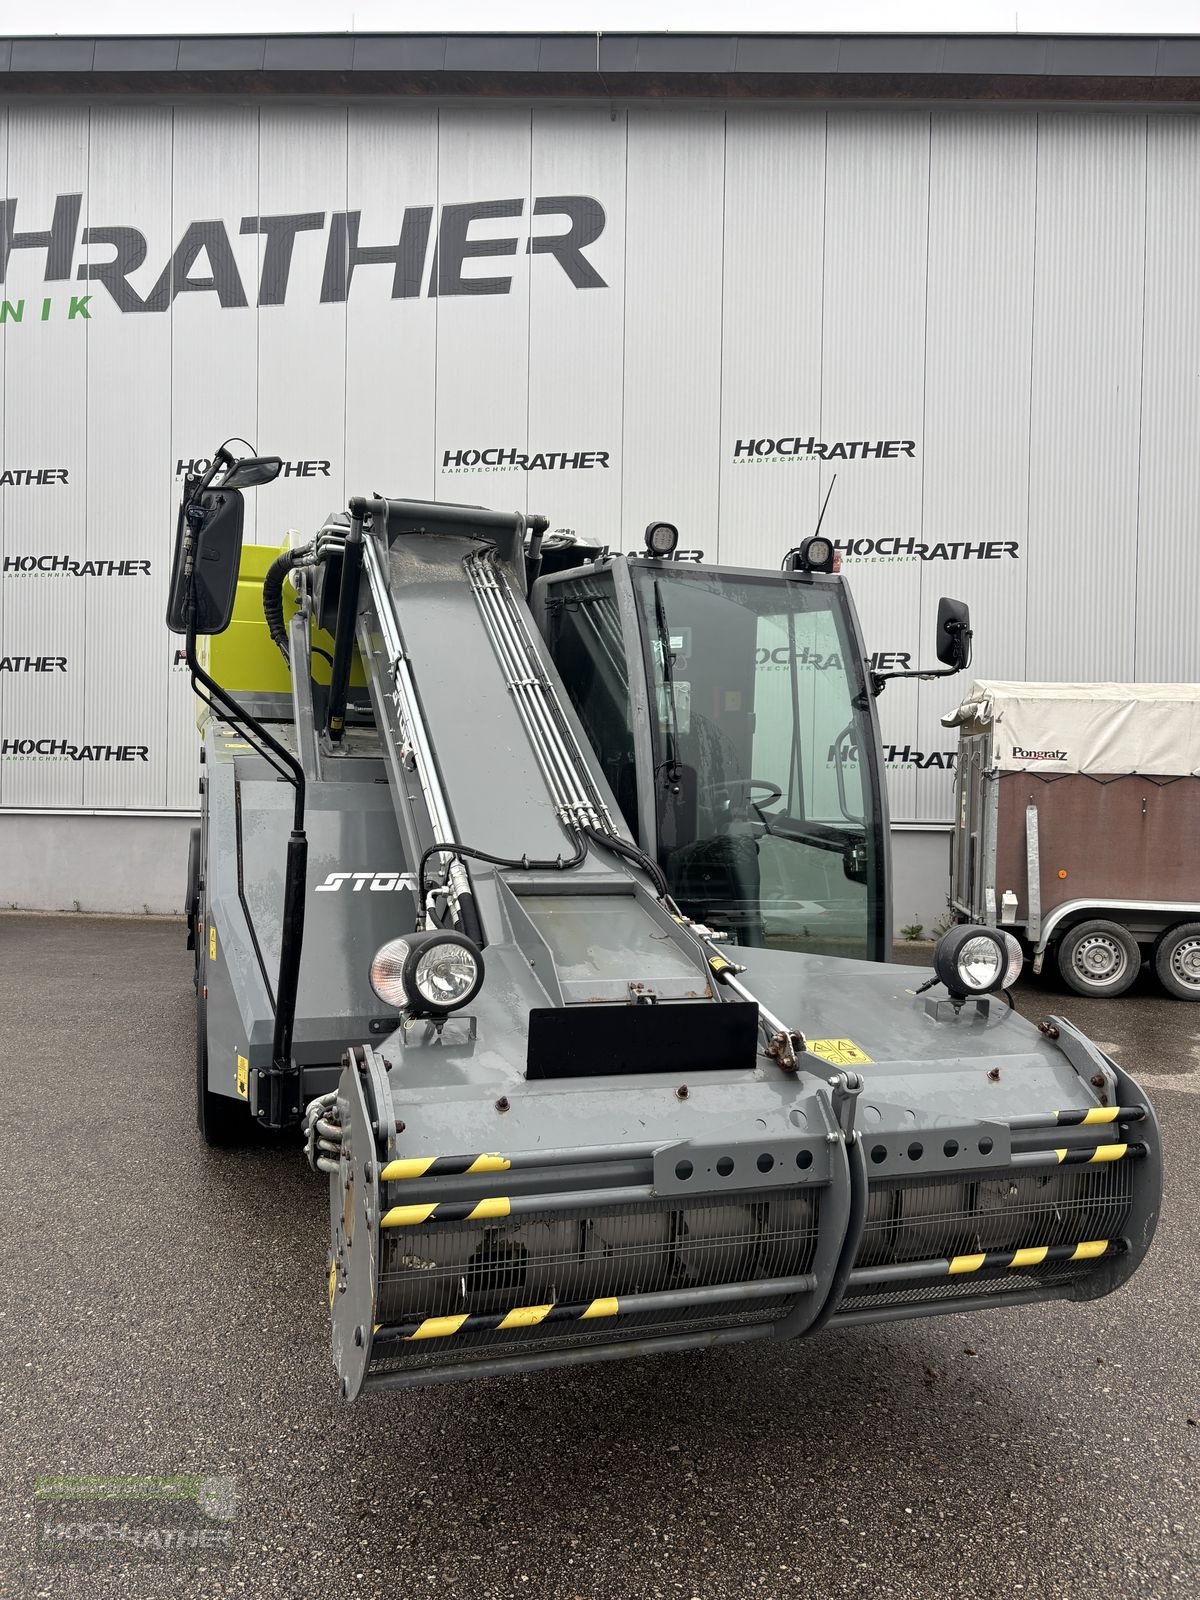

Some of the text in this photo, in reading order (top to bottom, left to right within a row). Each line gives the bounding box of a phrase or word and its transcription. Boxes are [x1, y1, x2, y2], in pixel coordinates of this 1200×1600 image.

[0, 192, 609, 313] HRATHER
[0, 295, 93, 323] NIK
[442, 448, 609, 470] HOCHRATHER
[734, 437, 916, 460] HOCHRATHER
[441, 465, 519, 474] LANDTECHNIK
[732, 455, 817, 464] LANDTECHNIK
[0, 469, 69, 486] ATHER
[833, 537, 1019, 560] HOCHRATHER
[3, 555, 151, 576] HOCHRATHER
[0, 657, 67, 672] ATHER
[1, 739, 149, 761] HOCHRATHER
[1012, 746, 1067, 761] Pongratz
[315, 872, 417, 891] STOR
